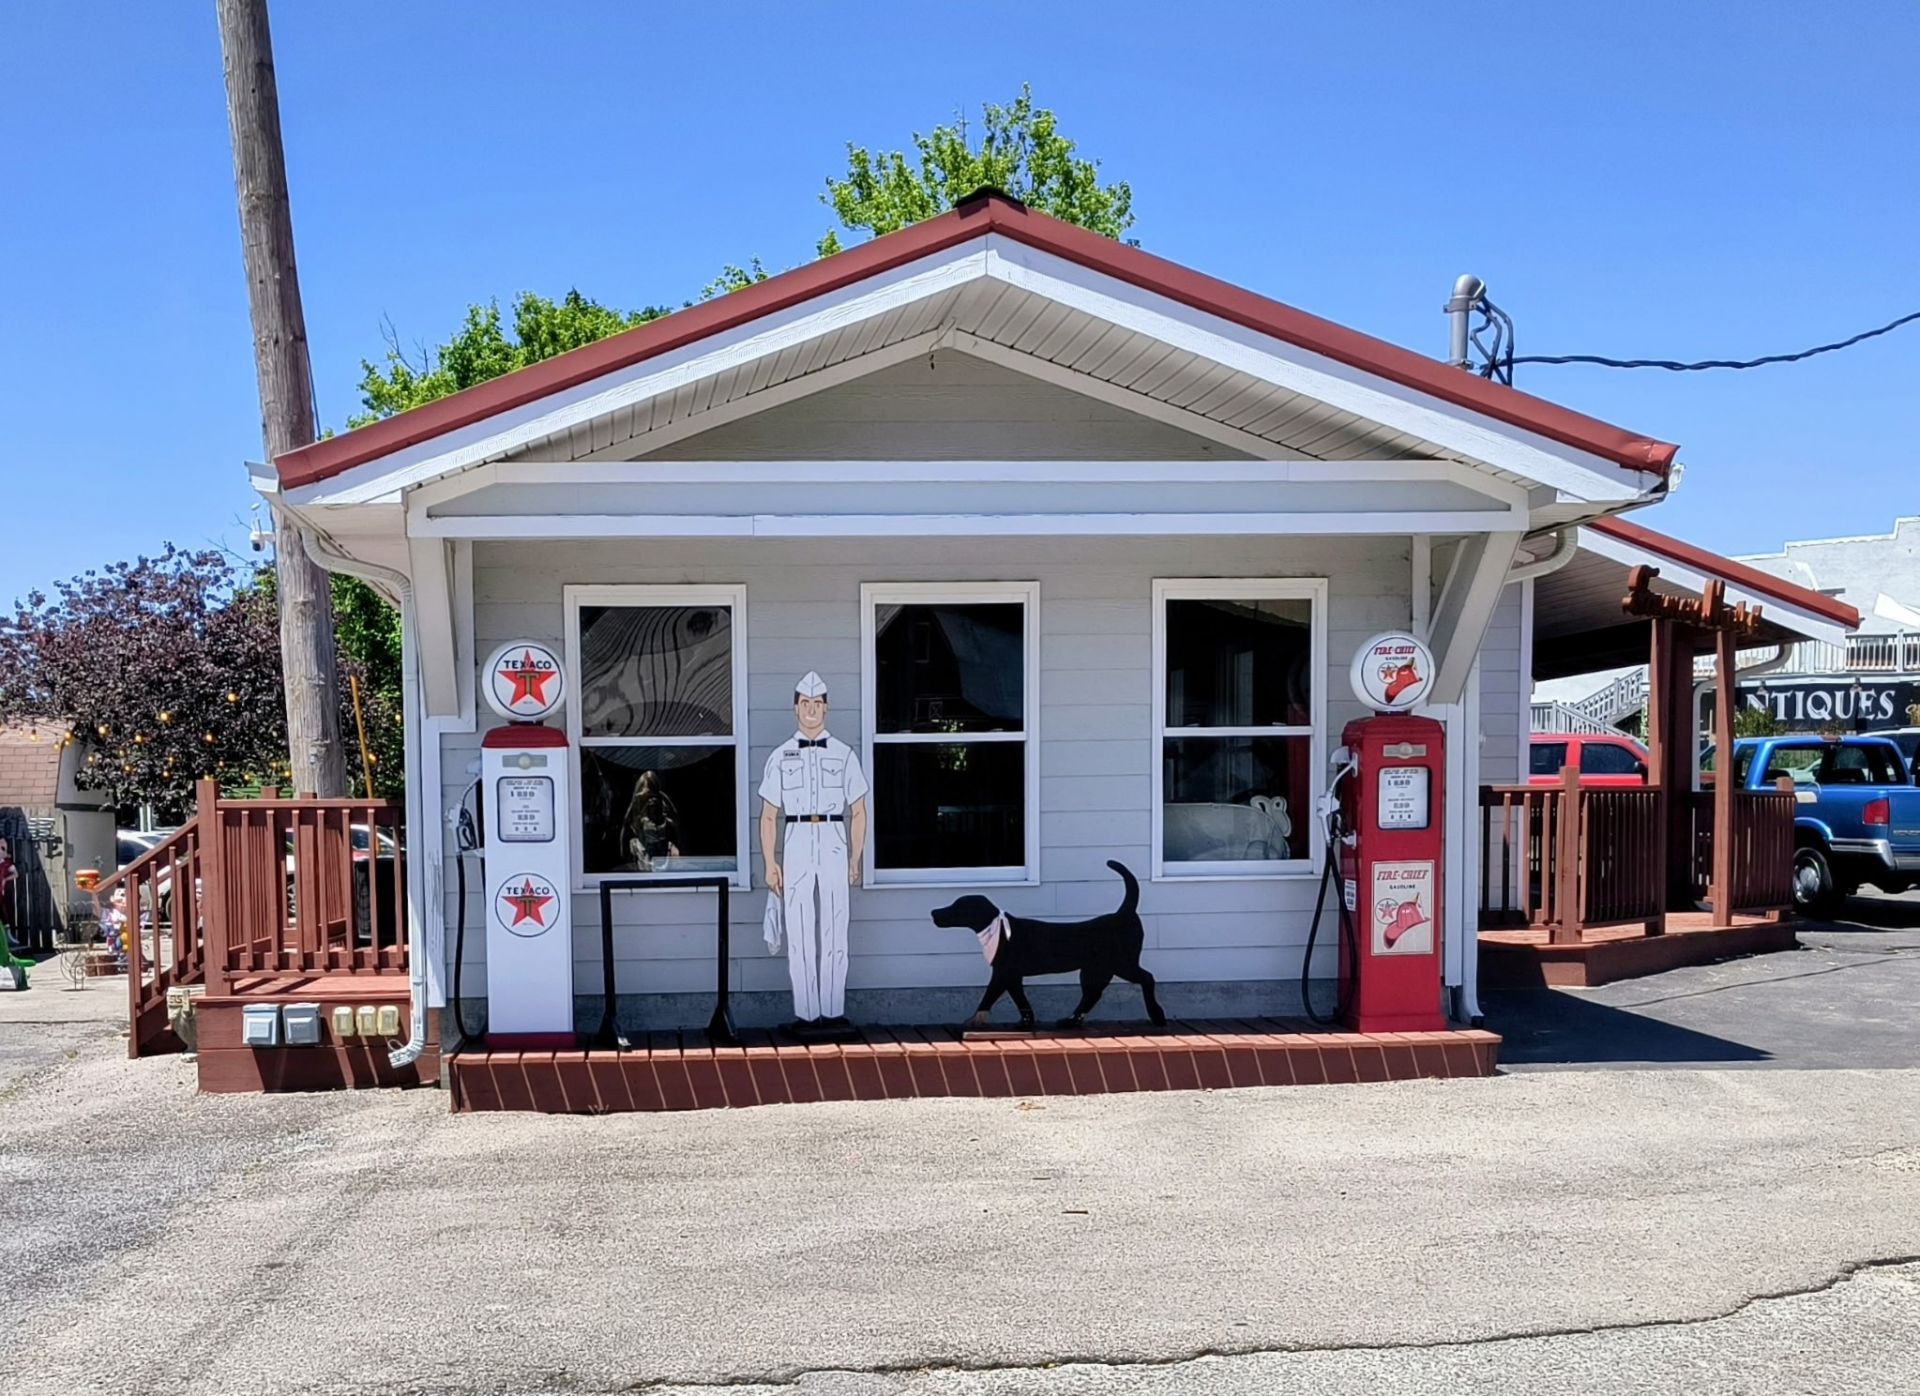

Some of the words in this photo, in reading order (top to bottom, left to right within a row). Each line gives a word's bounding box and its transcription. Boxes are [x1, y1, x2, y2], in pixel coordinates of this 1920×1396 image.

[503, 660, 552, 669] TEXACO
[1376, 869, 1430, 880] FIRE-CHIEF
[505, 886, 551, 895] TEXACO
